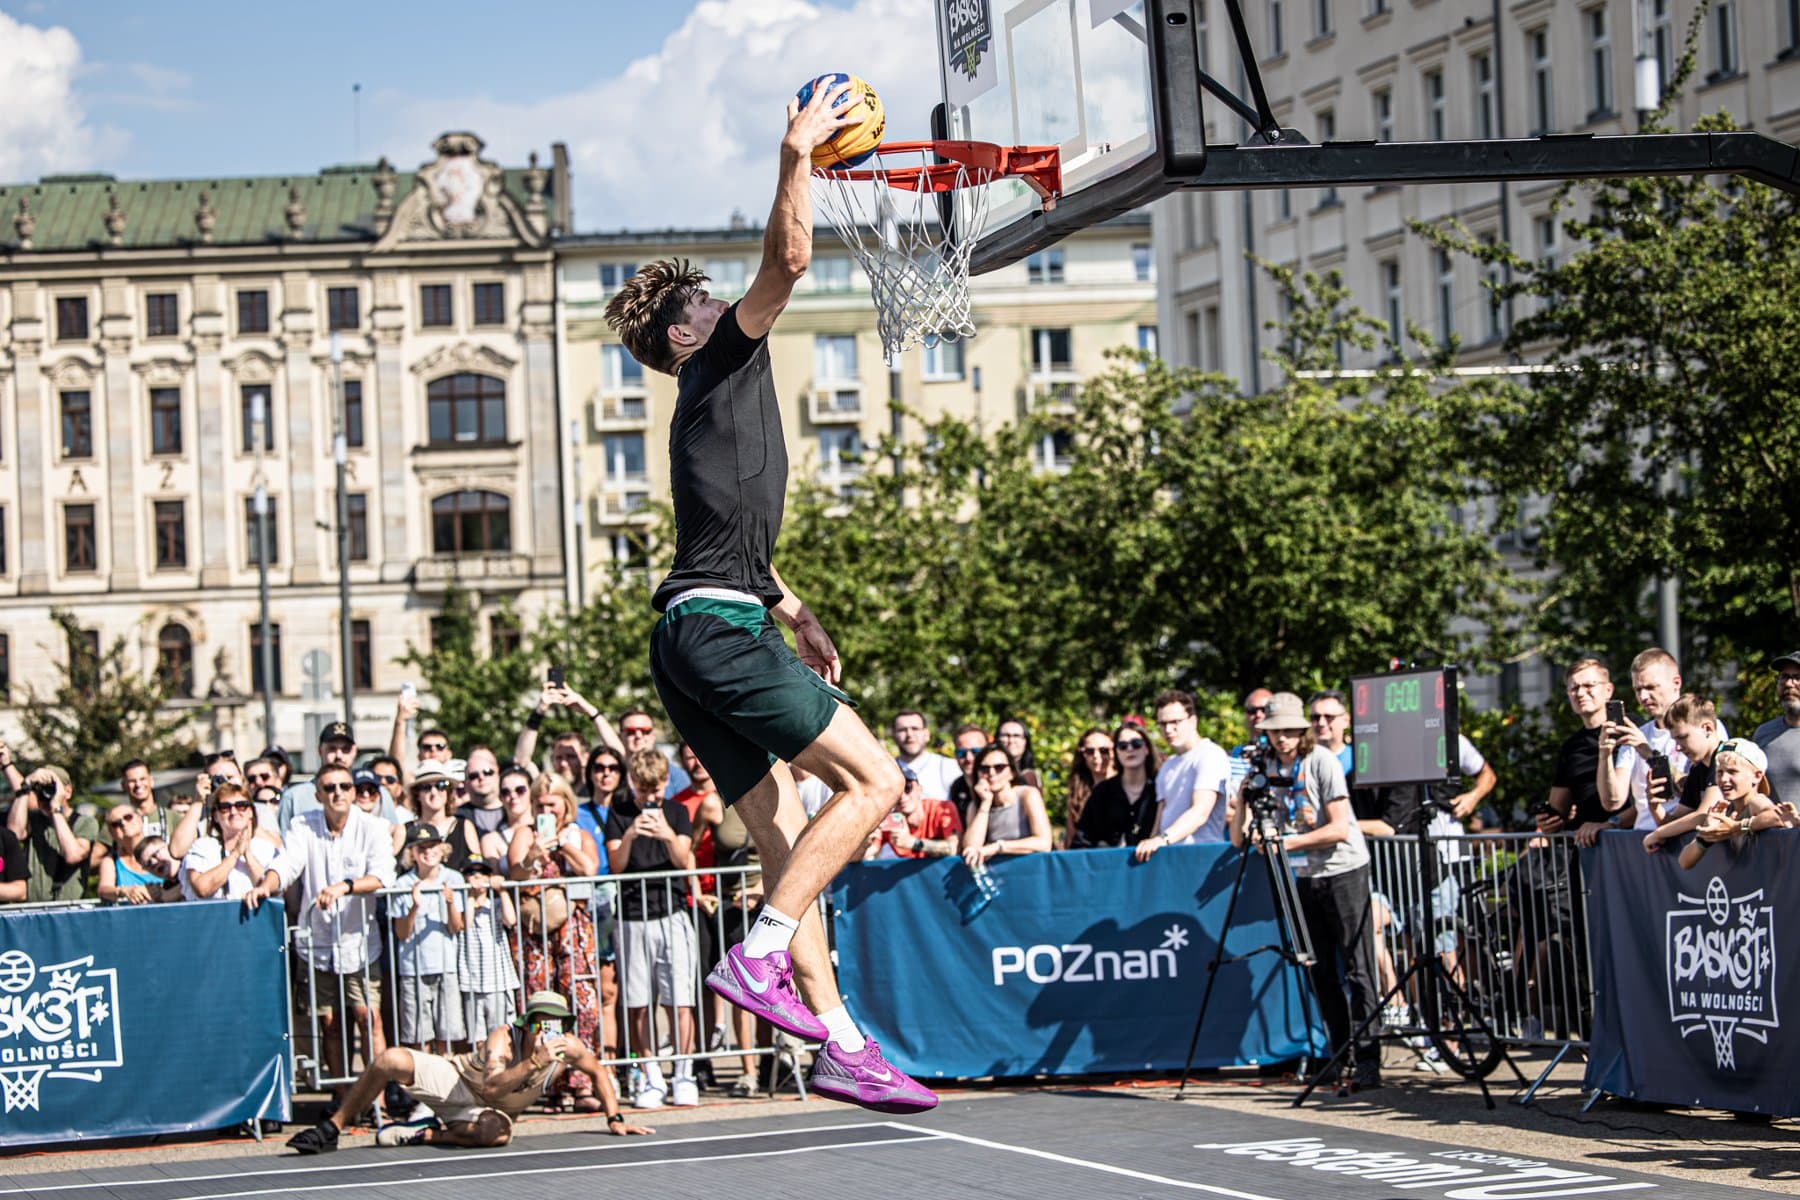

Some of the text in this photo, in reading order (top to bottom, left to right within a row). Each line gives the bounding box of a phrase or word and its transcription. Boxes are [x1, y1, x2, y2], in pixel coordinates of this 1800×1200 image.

[1680, 990, 1763, 1012] NA WOLNOŚCI
[0, 1040, 98, 1063] OLNOŚCI
